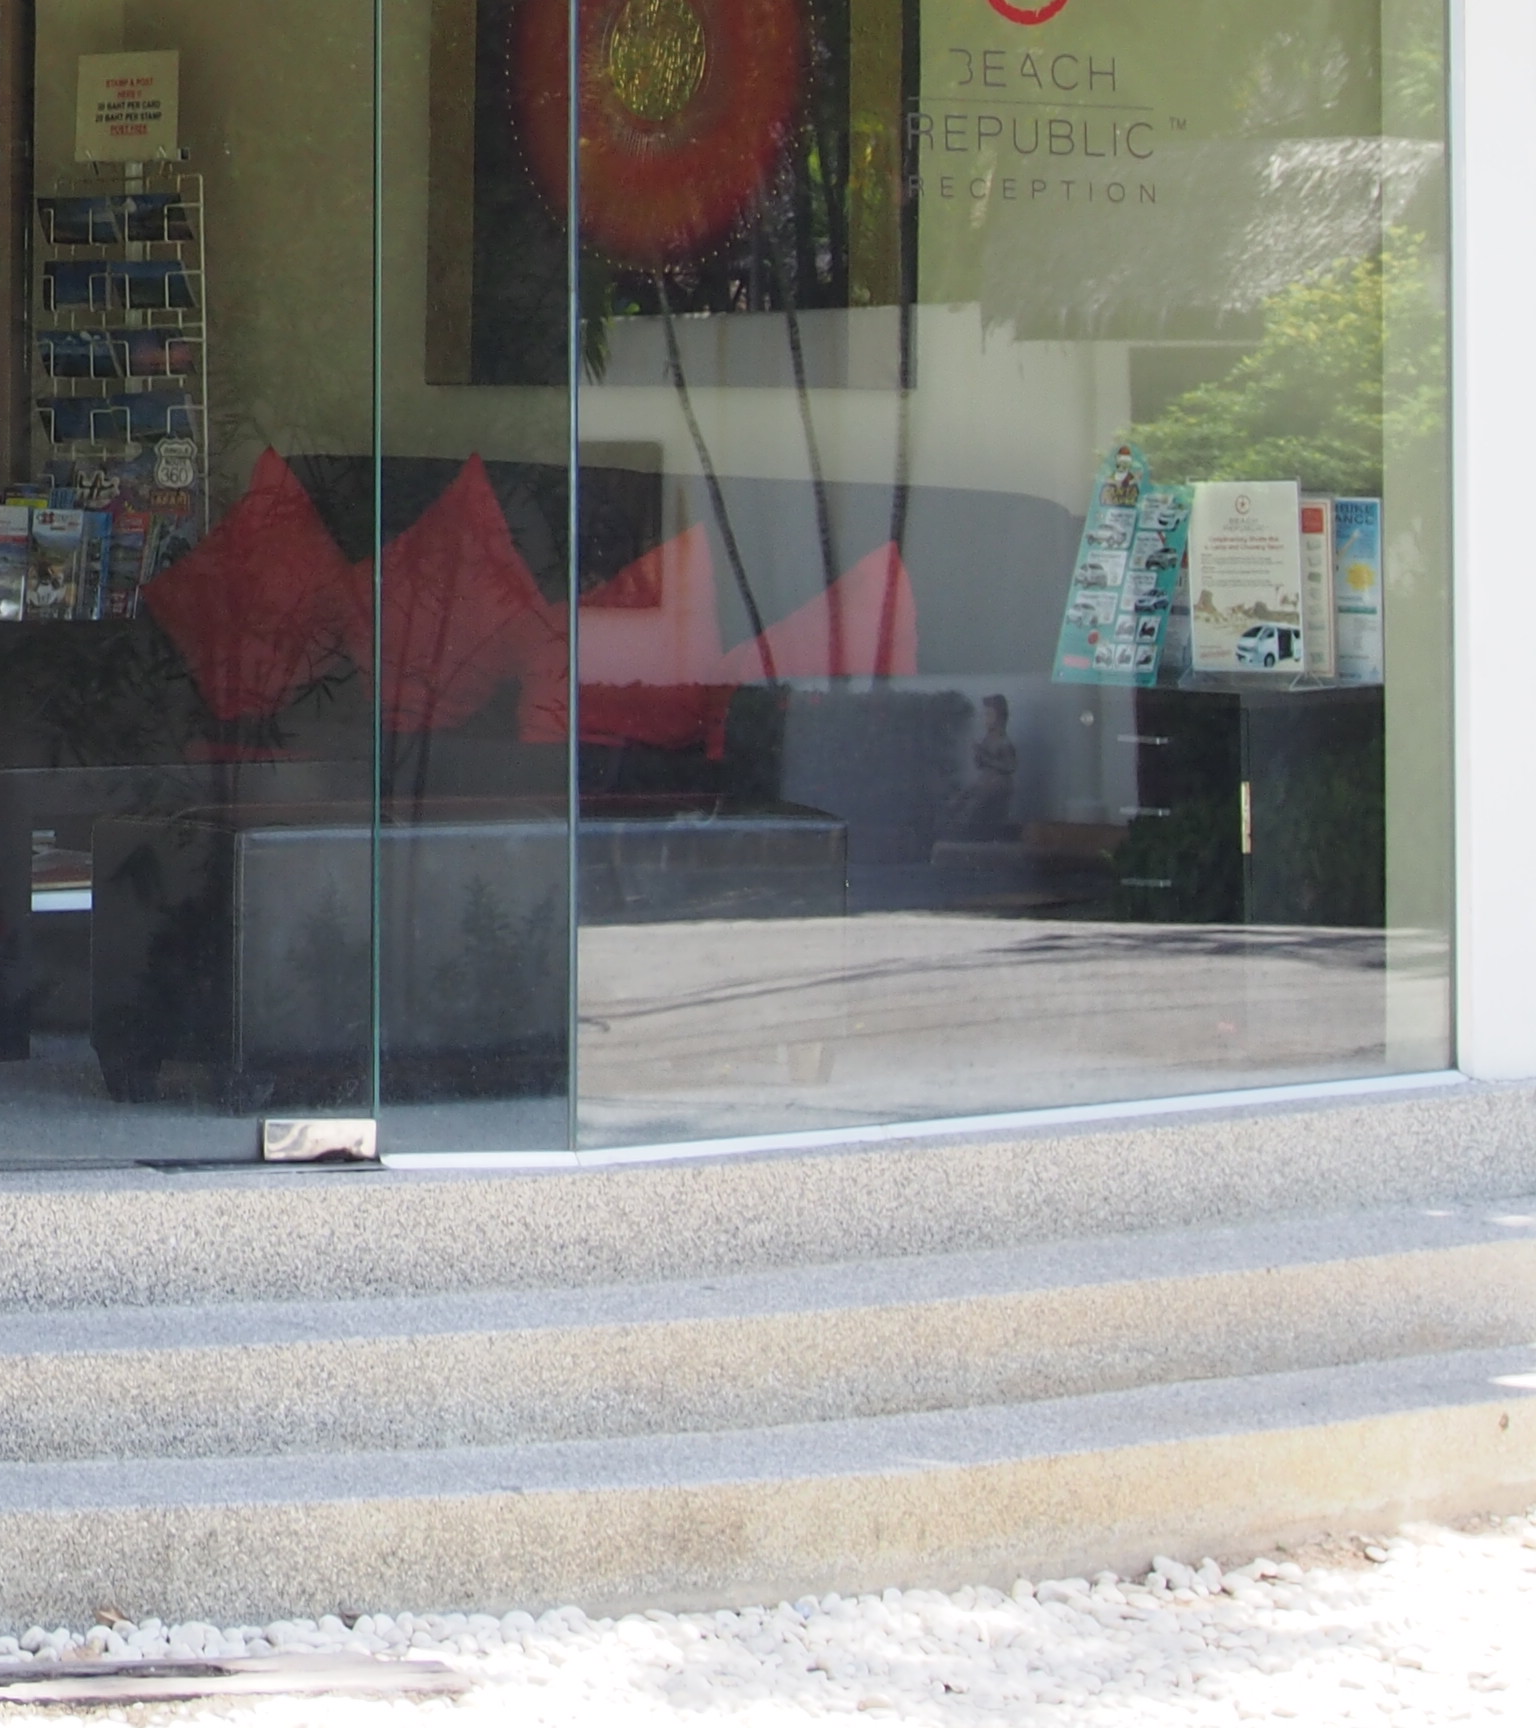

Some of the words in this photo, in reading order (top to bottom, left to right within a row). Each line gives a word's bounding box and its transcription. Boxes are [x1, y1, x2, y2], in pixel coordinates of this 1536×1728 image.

[948, 47, 1116, 92] BEACH
[105, 113, 124, 122] BAHT
[124, 112, 139, 121] PER
[140, 111, 162, 121] STAMP
[106, 101, 125, 111] BAHT
[126, 100, 141, 110] PER
[142, 100, 161, 110] CARD
[906, 112, 1155, 159] REPUBLIC
[907, 175, 1158, 205] RECEPTION
[160, 467, 189, 483] 360
